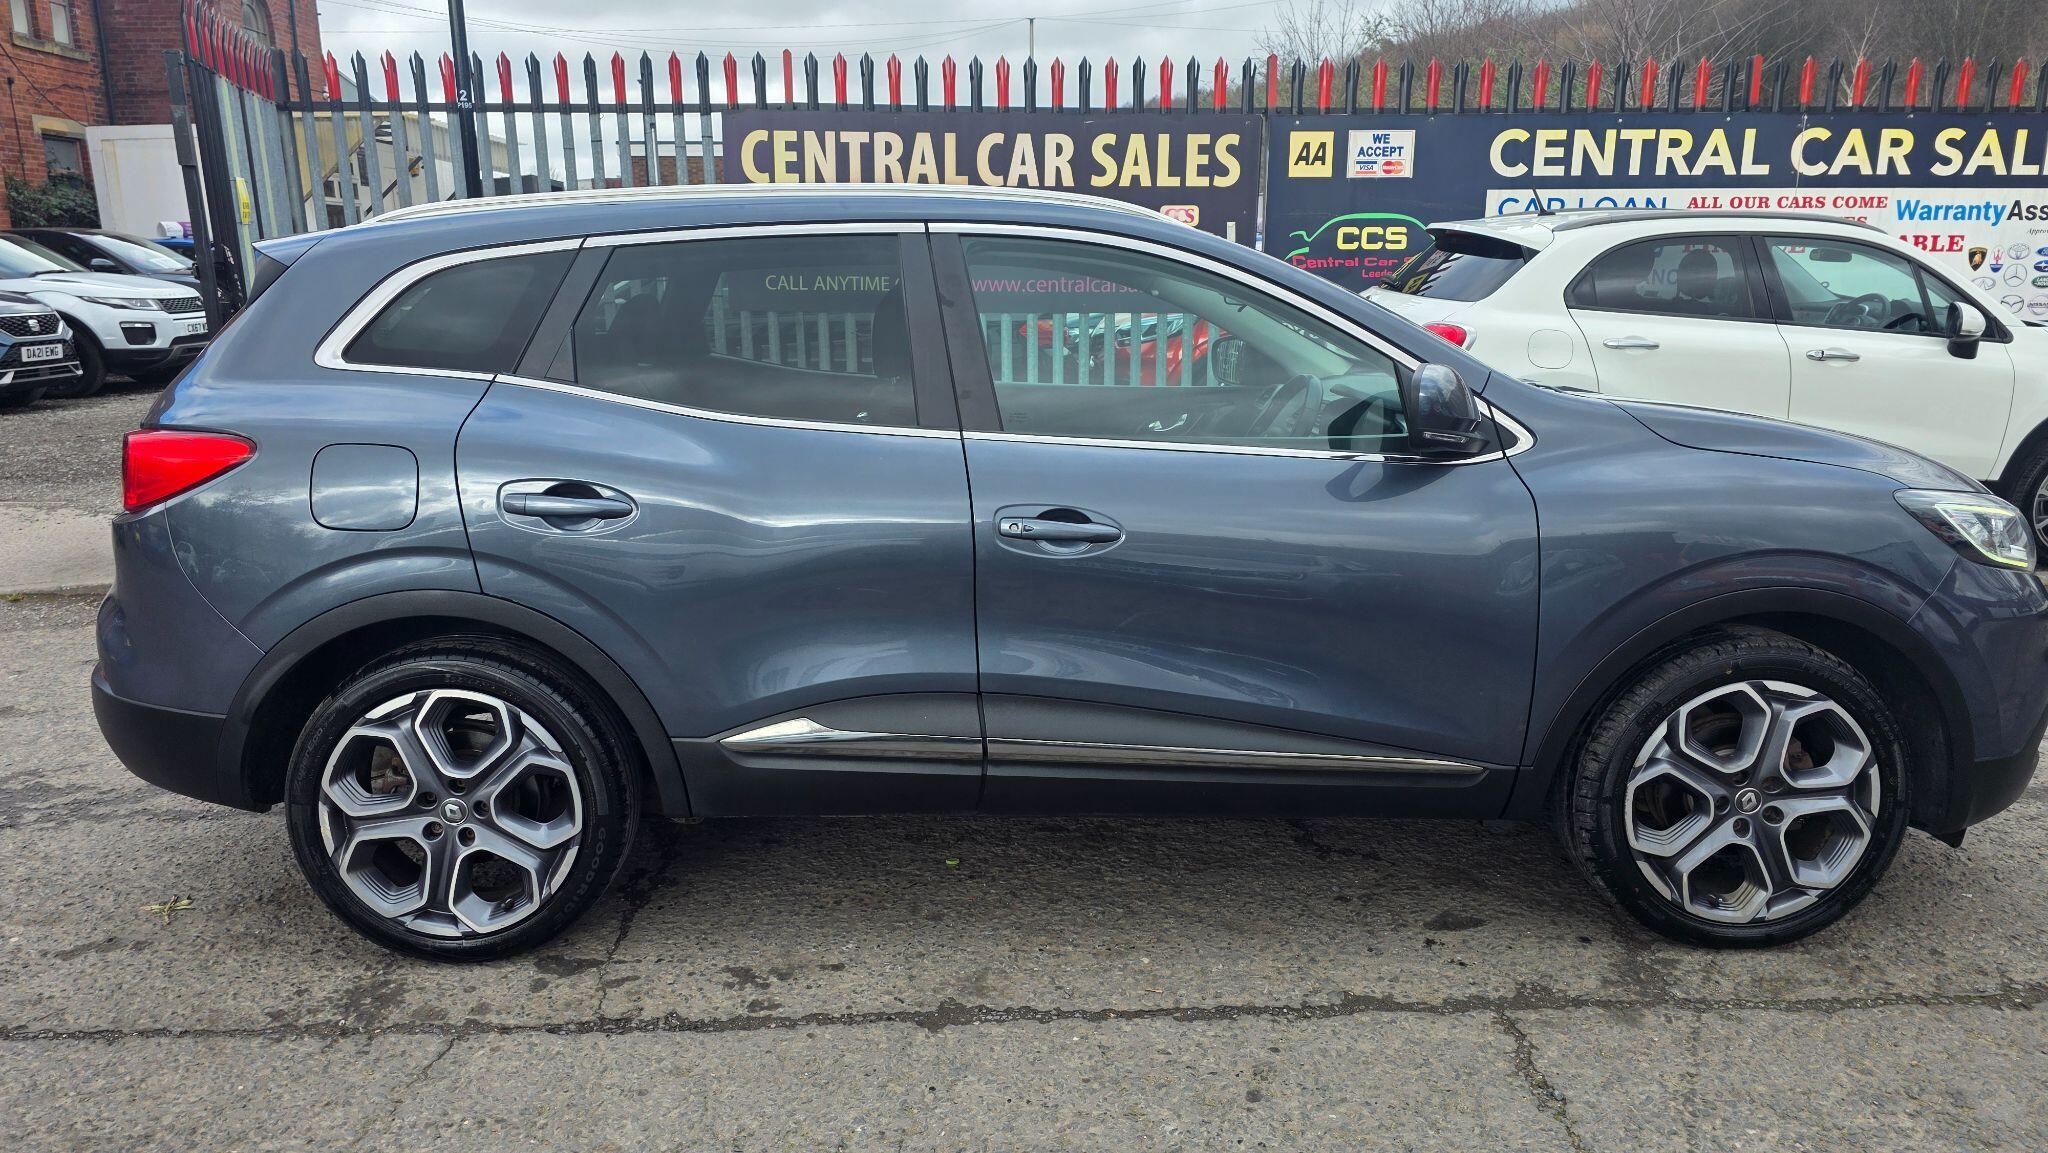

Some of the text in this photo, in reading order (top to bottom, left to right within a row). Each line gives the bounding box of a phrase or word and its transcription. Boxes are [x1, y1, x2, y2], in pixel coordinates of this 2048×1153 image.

[459, 89, 468, 101] 2
[1372, 133, 1391, 145] WE
[741, 129, 1241, 188] CENTRAL CAR SALES
[1294, 141, 1327, 166] AA
[1357, 146, 1405, 158] ACCEPT
[1489, 127, 2048, 177] CENTRAL CAR SAL
[1686, 196, 1889, 210] ALL OUR CARS COME
[1336, 226, 1408, 250] CCS
[1899, 234, 1966, 253] BLE
[1292, 255, 1359, 270] Central
[1364, 257, 1399, 267] Car
[765, 275, 891, 292] CALL ANYTIME
[27, 347, 45, 359] DA21
